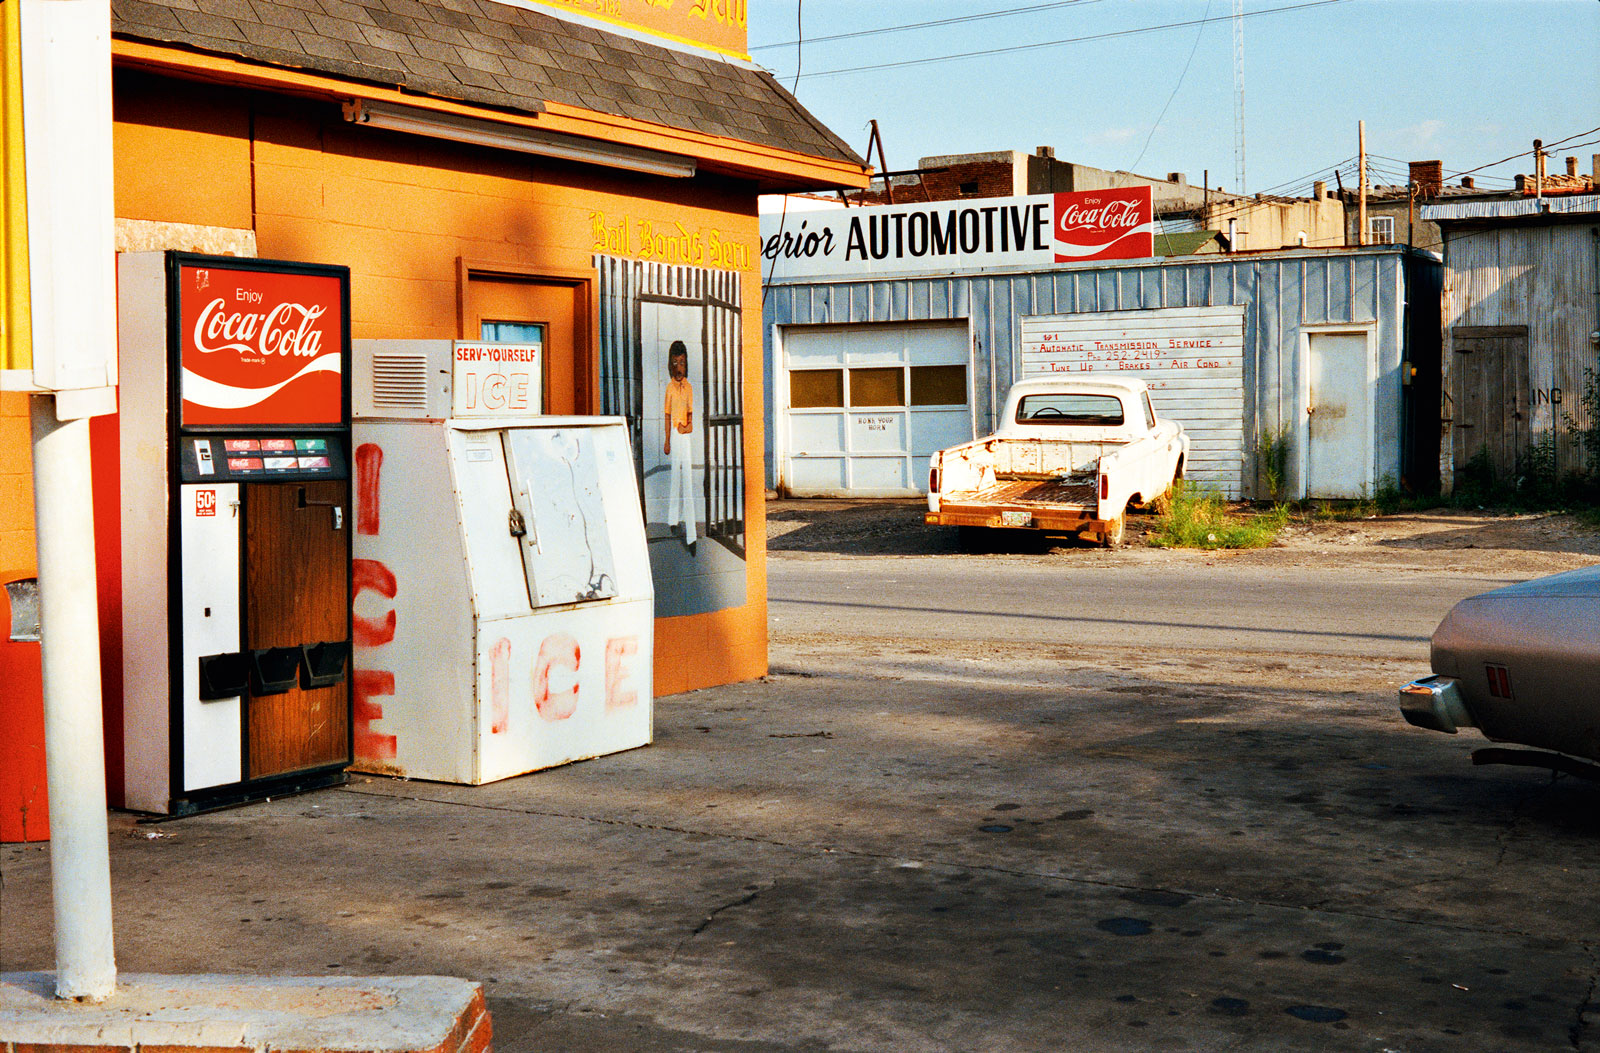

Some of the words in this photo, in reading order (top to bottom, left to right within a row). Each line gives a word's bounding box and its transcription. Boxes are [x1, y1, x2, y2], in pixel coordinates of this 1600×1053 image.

[760, 219, 837, 260] erior
[845, 203, 1050, 261] AUTOMOTIVE
[1060, 199, 1143, 231] Coca-Cola
[588, 210, 633, 256] Bail
[637, 220, 704, 266] Bonds
[236, 287, 263, 304] Enjoy
[193, 297, 327, 357] Coca-Cola
[456, 348, 536, 362] SERV-YOURSELF
[1039, 343, 1084, 352] AUTOMATIC
[1094, 341, 1158, 351] TRANSMISSION
[1169, 339, 1212, 349] SERVICE
[1050, 363, 1070, 371] TUNE
[1080, 362, 1093, 372] UP
[1119, 361, 1151, 370] BRAKES
[1171, 360, 1188, 369] AIR
[466, 372, 529, 410] ICE
[196, 491, 216, 509] 50¢
[352, 443, 398, 760] ICE
[488, 633, 639, 735] ICE
